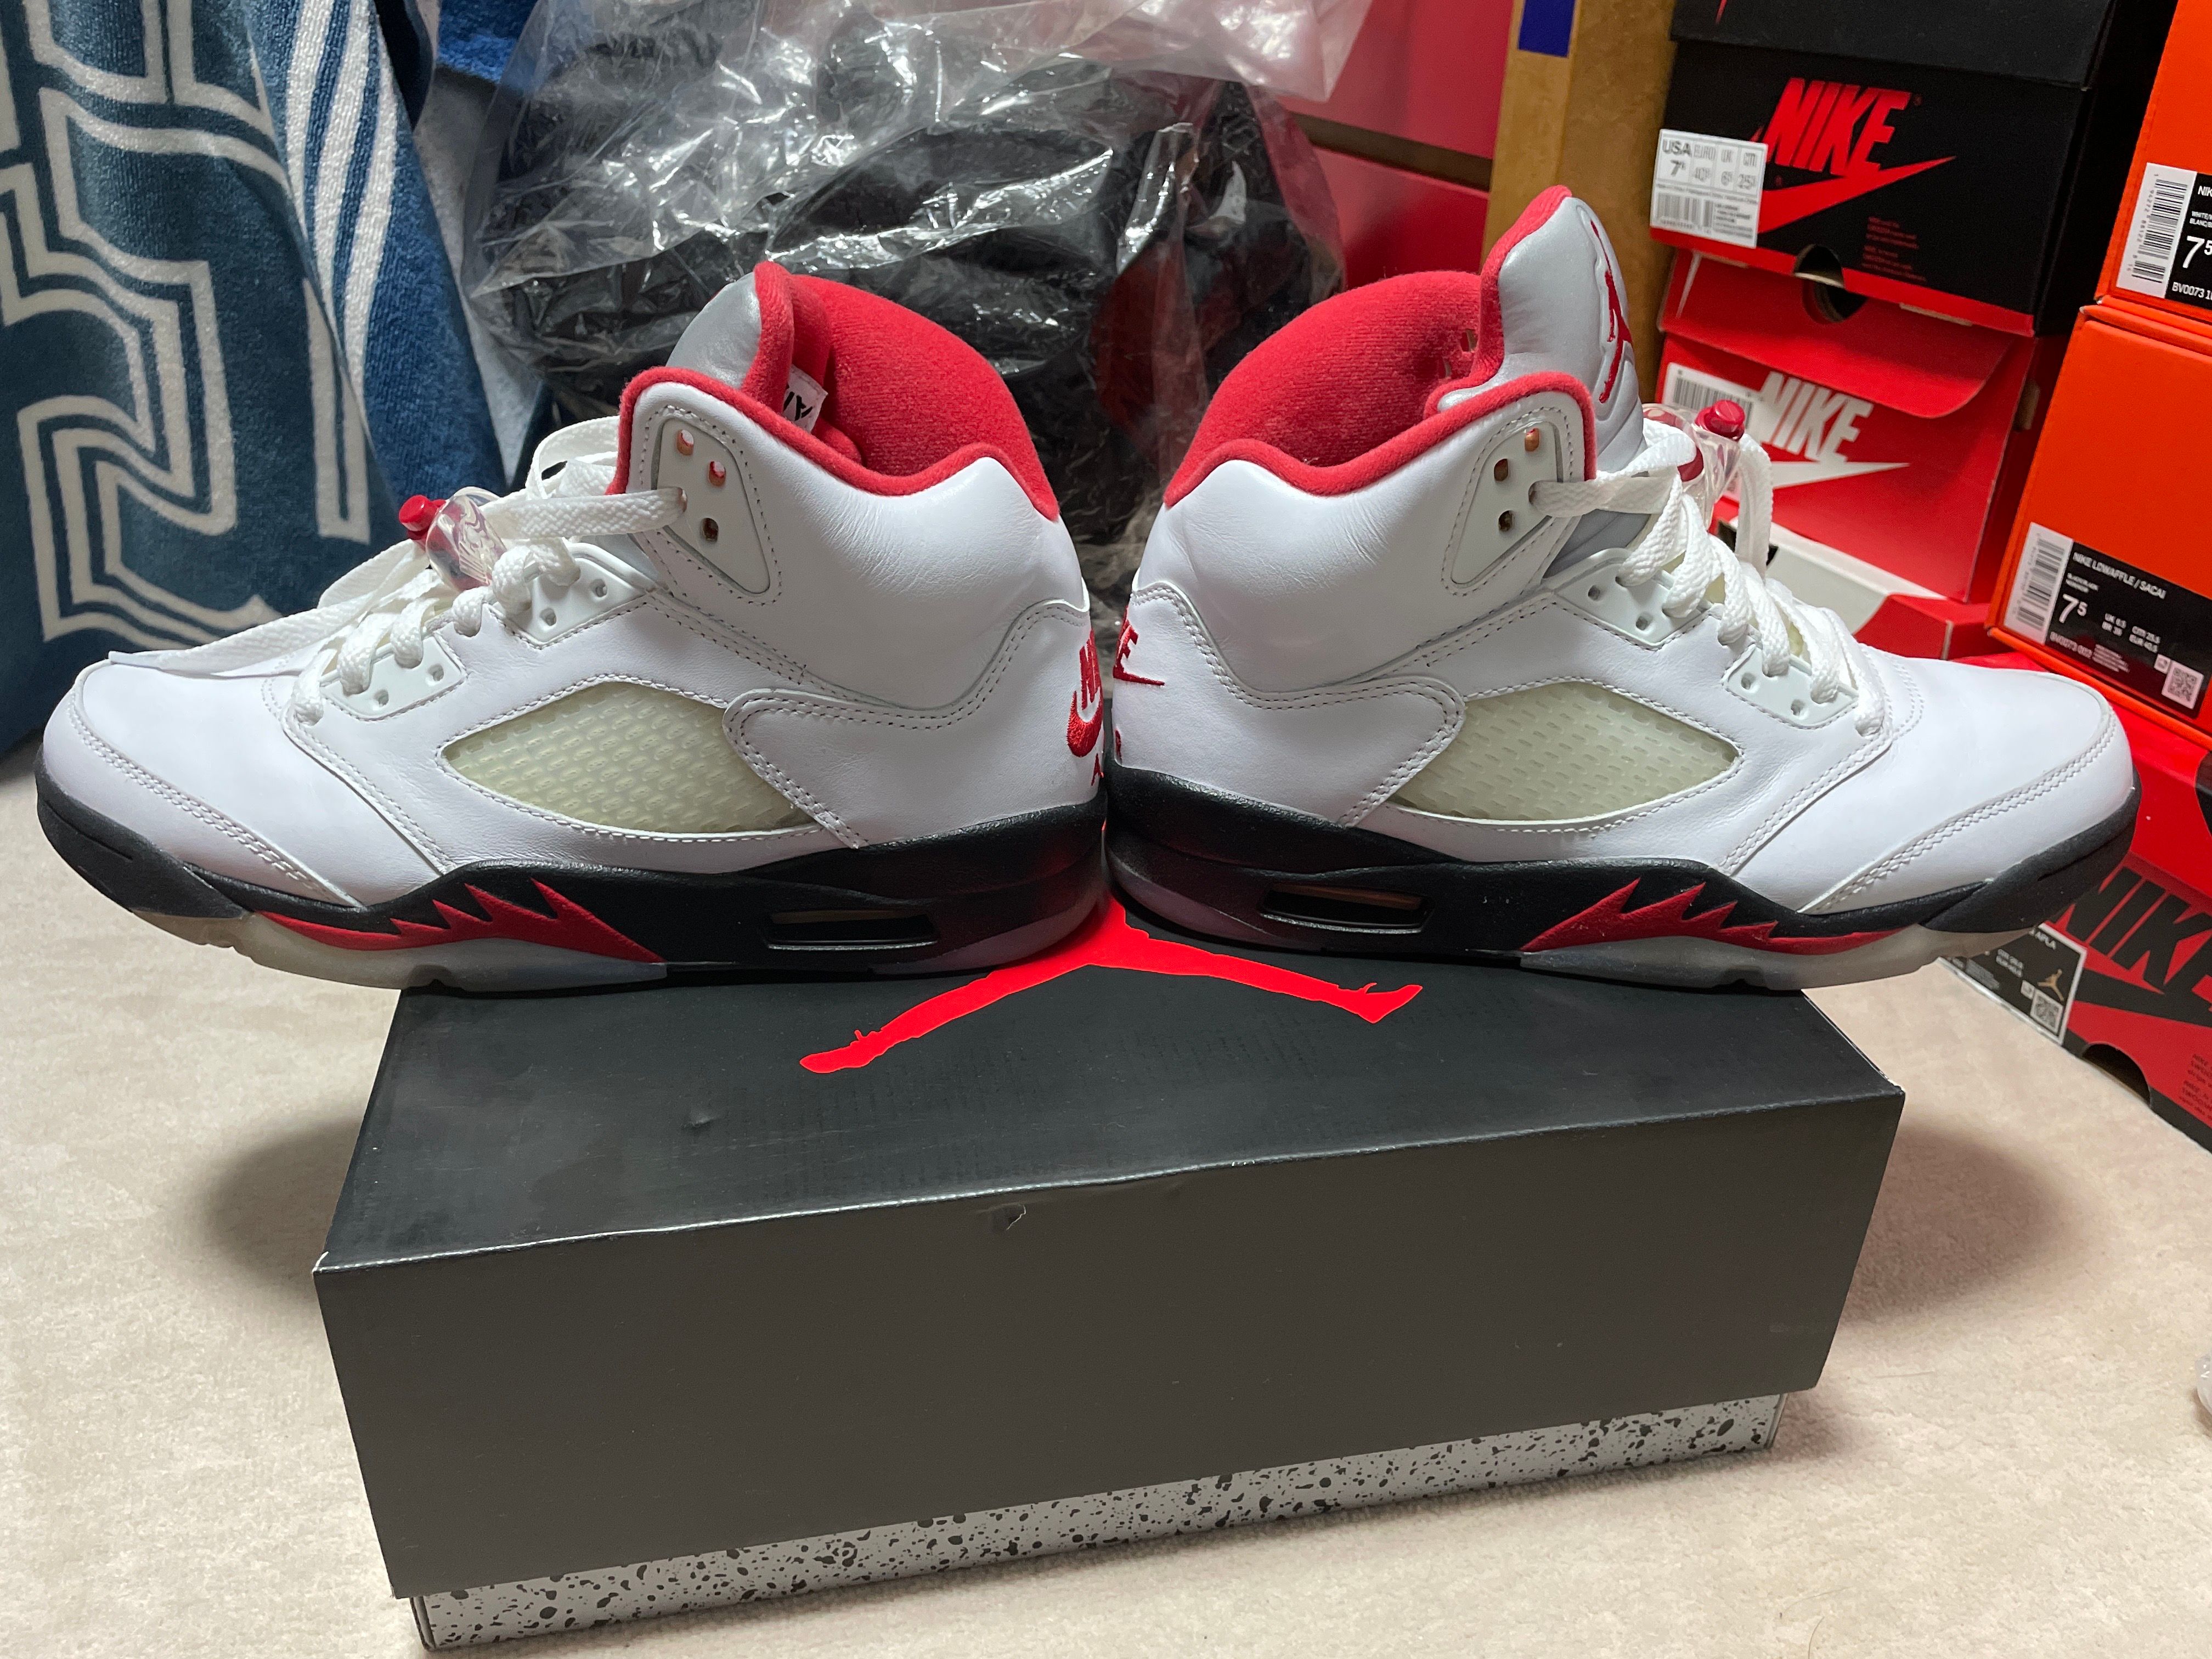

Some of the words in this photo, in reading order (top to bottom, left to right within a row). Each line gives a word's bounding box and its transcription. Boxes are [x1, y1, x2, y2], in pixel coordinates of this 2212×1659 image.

[1662, 138, 1691, 157] USA
[1762, 77, 1912, 178] NIKE
[2172, 281, 2204, 298] BV0073
[1758, 371, 1874, 463] NIKE
[2073, 552, 2092, 568] NIKE
[2140, 580, 2167, 600] SACAI
